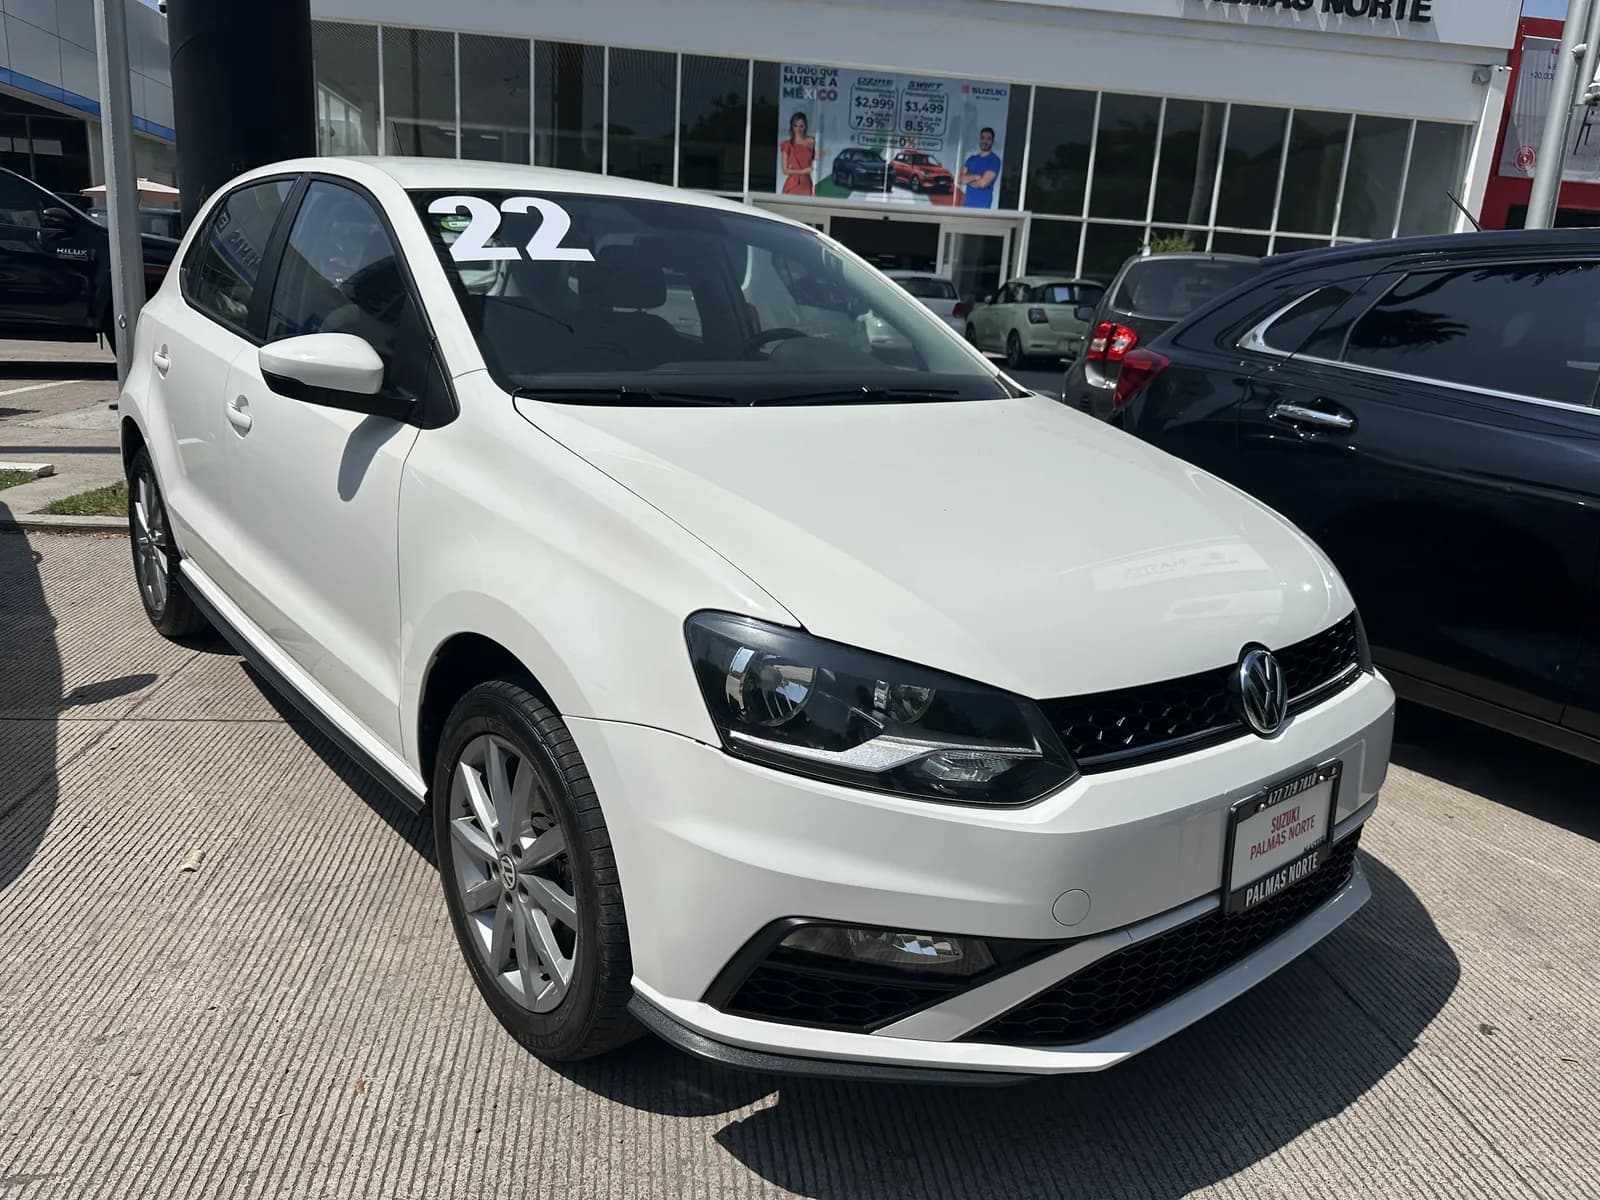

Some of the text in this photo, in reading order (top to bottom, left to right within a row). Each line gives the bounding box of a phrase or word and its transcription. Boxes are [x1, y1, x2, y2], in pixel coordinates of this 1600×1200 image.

[784, 66, 795, 74] EL
[820, 68, 838, 78] QUE
[784, 75, 837, 87] MUEVE A
[907, 81, 943, 89] SWIFT
[972, 87, 1008, 96] SUZUKI
[855, 96, 894, 109] $2,999
[905, 101, 944, 113] $3,499
[428, 195, 596, 261] 22
[1271, 806, 1300, 833] SUZUKI
[1250, 814, 1315, 860] PALMAS NORTE
[1246, 851, 1318, 907] PALMAS NORTE
